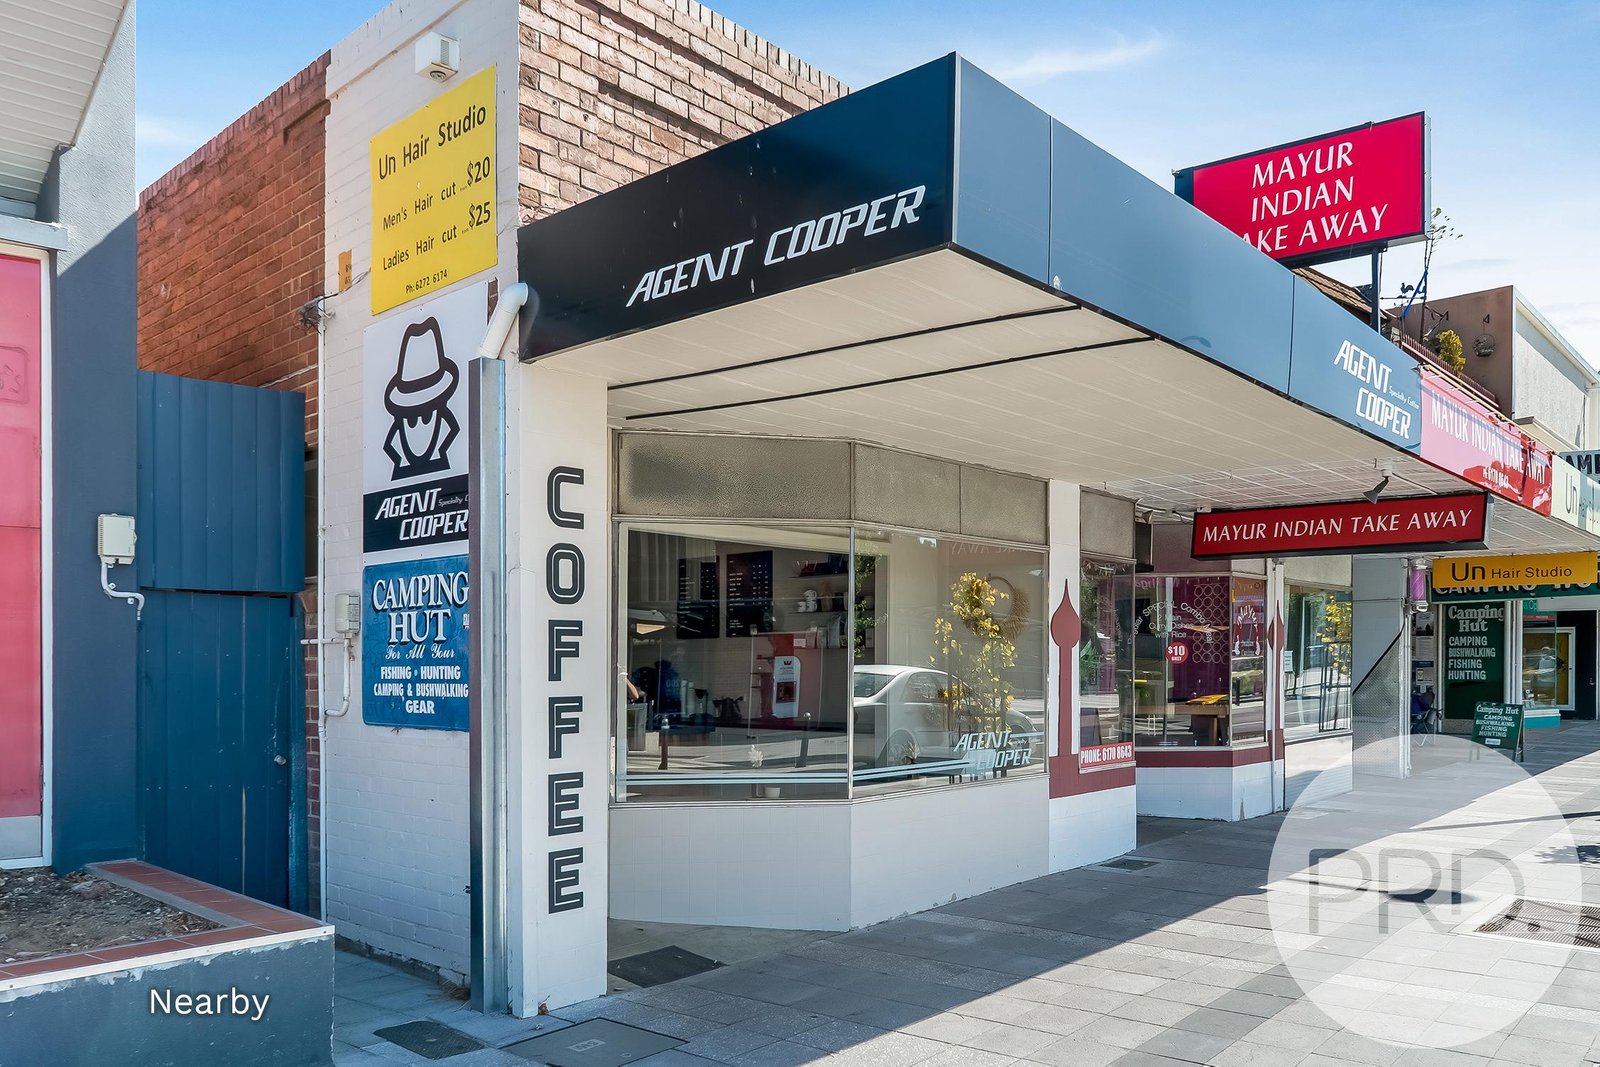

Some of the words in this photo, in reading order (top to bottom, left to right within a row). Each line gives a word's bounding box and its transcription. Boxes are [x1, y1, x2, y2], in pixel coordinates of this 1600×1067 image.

[379, 154, 396, 180] Un
[403, 134, 429, 167] Hair
[438, 104, 486, 147] Studio
[1252, 141, 1353, 189] MAYUR
[383, 207, 407, 231] Men's
[414, 193, 433, 214] Hair
[440, 182, 456, 200] cut
[467, 156, 490, 187] $20
[1251, 176, 1354, 223] INDIAN
[383, 249, 409, 271] Ladies
[416, 235, 434, 256] Hair
[441, 225, 457, 243] cut
[468, 201, 491, 230] $25
[1242, 225, 1289, 253] KE
[1298, 203, 1388, 246] AWAY
[625, 239, 754, 308] AGENT
[764, 184, 926, 266] COOPER
[1333, 339, 1393, 394] AGENT
[1356, 387, 1412, 439] COOPER
[1431, 390, 1469, 443] MAYUR
[1471, 414, 1503, 469] INDIAN
[374, 487, 442, 520] AGENT
[1565, 471, 1578, 516] Un
[399, 509, 469, 541] COOPER
[1202, 523, 1267, 543] MAYUR
[1273, 517, 1343, 538] INDIAN
[1351, 514, 1400, 534] TAKE
[1407, 508, 1473, 530] AWAY
[1451, 562, 1486, 582] Un
[1491, 568, 1521, 579] Hair
[1524, 566, 1572, 578] Studio
[372, 571, 469, 612] CAMPING
[389, 608, 451, 643] HUT
[1448, 604, 1504, 622] Camping
[1458, 619, 1488, 632] Hut
[385, 644, 401, 659] For
[405, 644, 426, 659] All
[431, 643, 455, 658] Your
[1167, 645, 1186, 656] $10
[1448, 635, 1488, 647] CAMPING
[1448, 647, 1496, 658] BUSHWALKING
[380, 665, 412, 680] FISHING
[420, 665, 461, 680] HUNTING
[1448, 658, 1482, 669] FISHING
[1448, 670, 1486, 680] HUNTING
[373, 682, 404, 697] CAMPING
[406, 682, 413, 697] &
[415, 682, 469, 698] BUSHWALKING
[546, 465, 585, 915] COFFEE
[405, 699, 435, 714] GEAR
[1483, 714, 1513, 722] CAMPING
[953, 731, 1013, 752] AGENT
[1080, 748, 1102, 764] PHONE:
[1102, 746, 1116, 761] 6170
[1116, 744, 1132, 760] 8643
